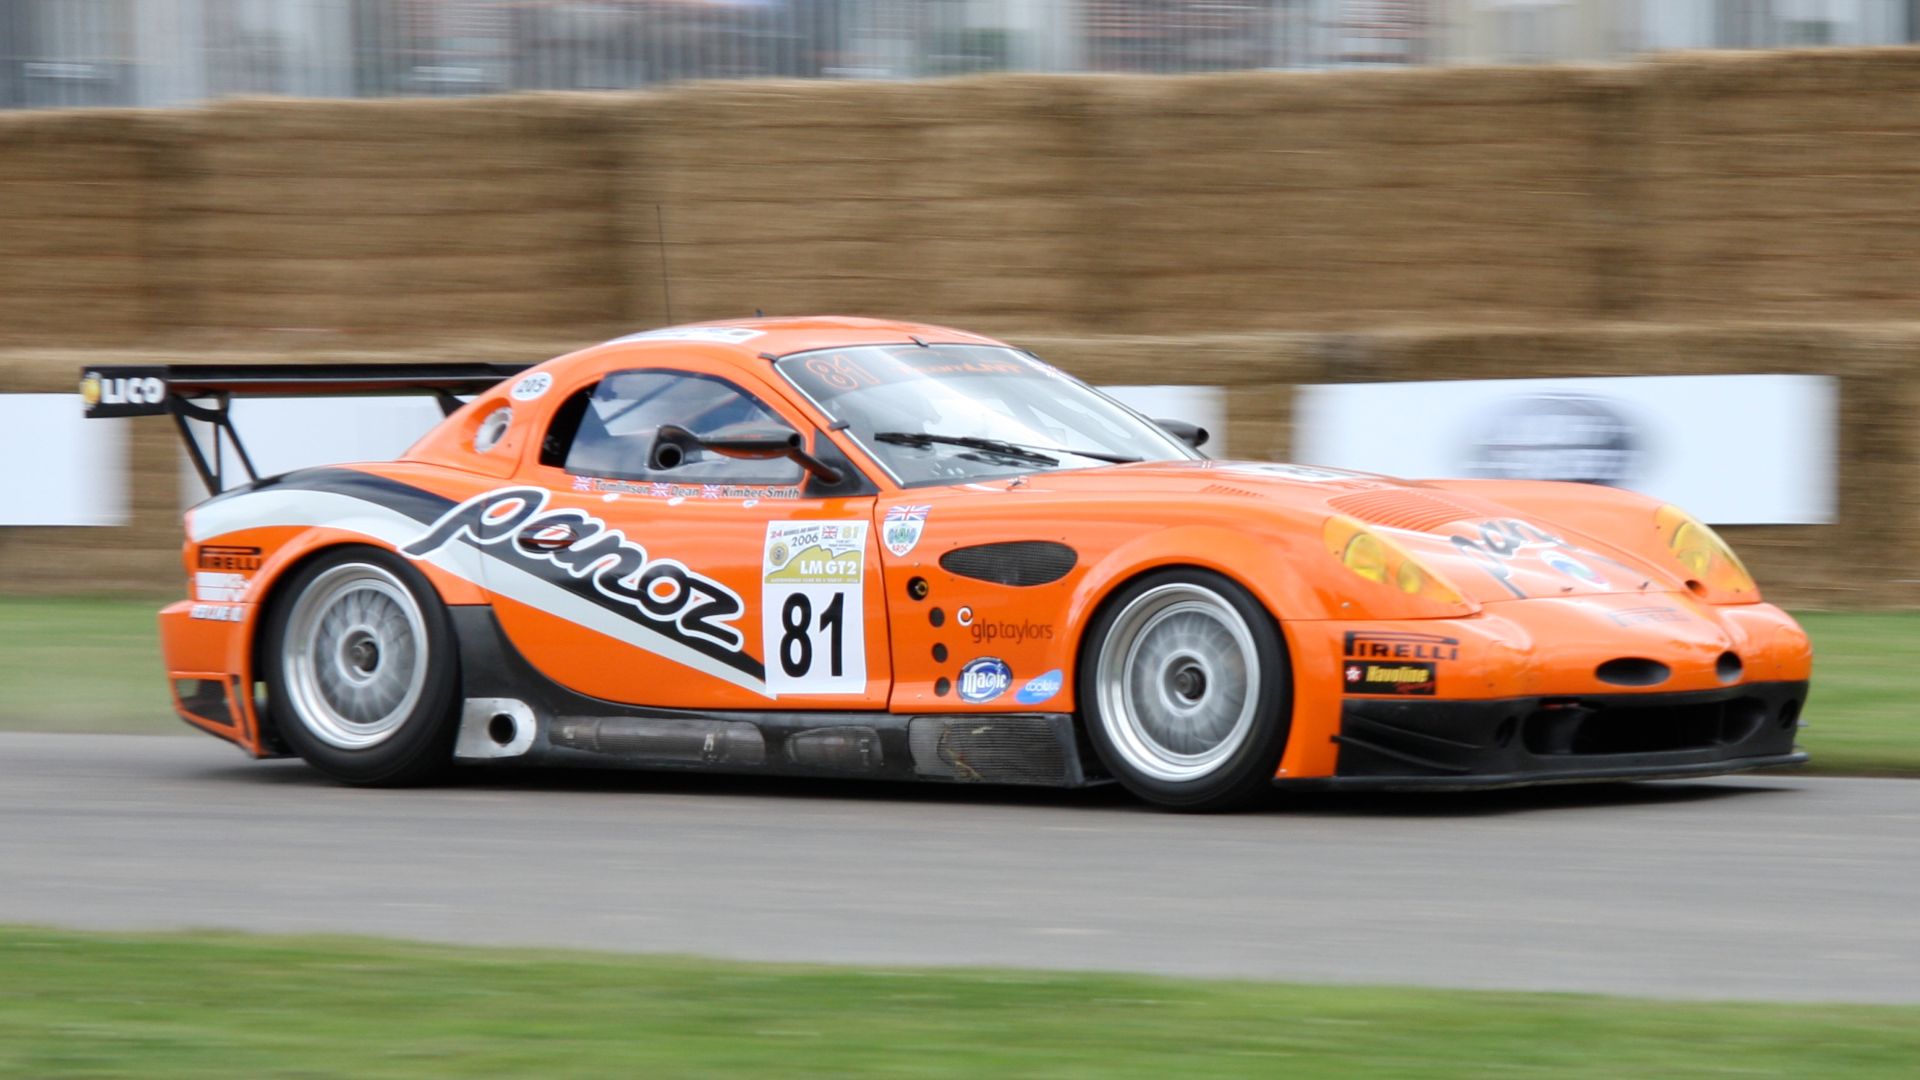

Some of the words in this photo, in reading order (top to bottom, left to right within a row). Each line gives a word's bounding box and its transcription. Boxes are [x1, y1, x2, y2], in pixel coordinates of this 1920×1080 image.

[593, 479, 650, 495] Tomlinson
[670, 485, 700, 498] Dean
[722, 485, 800, 499] Kimber-Smith
[791, 533, 819, 548] 2006
[780, 592, 845, 678] 81
[1000, 618, 1054, 645] taylors
[1344, 631, 1460, 660] PIRELLI
